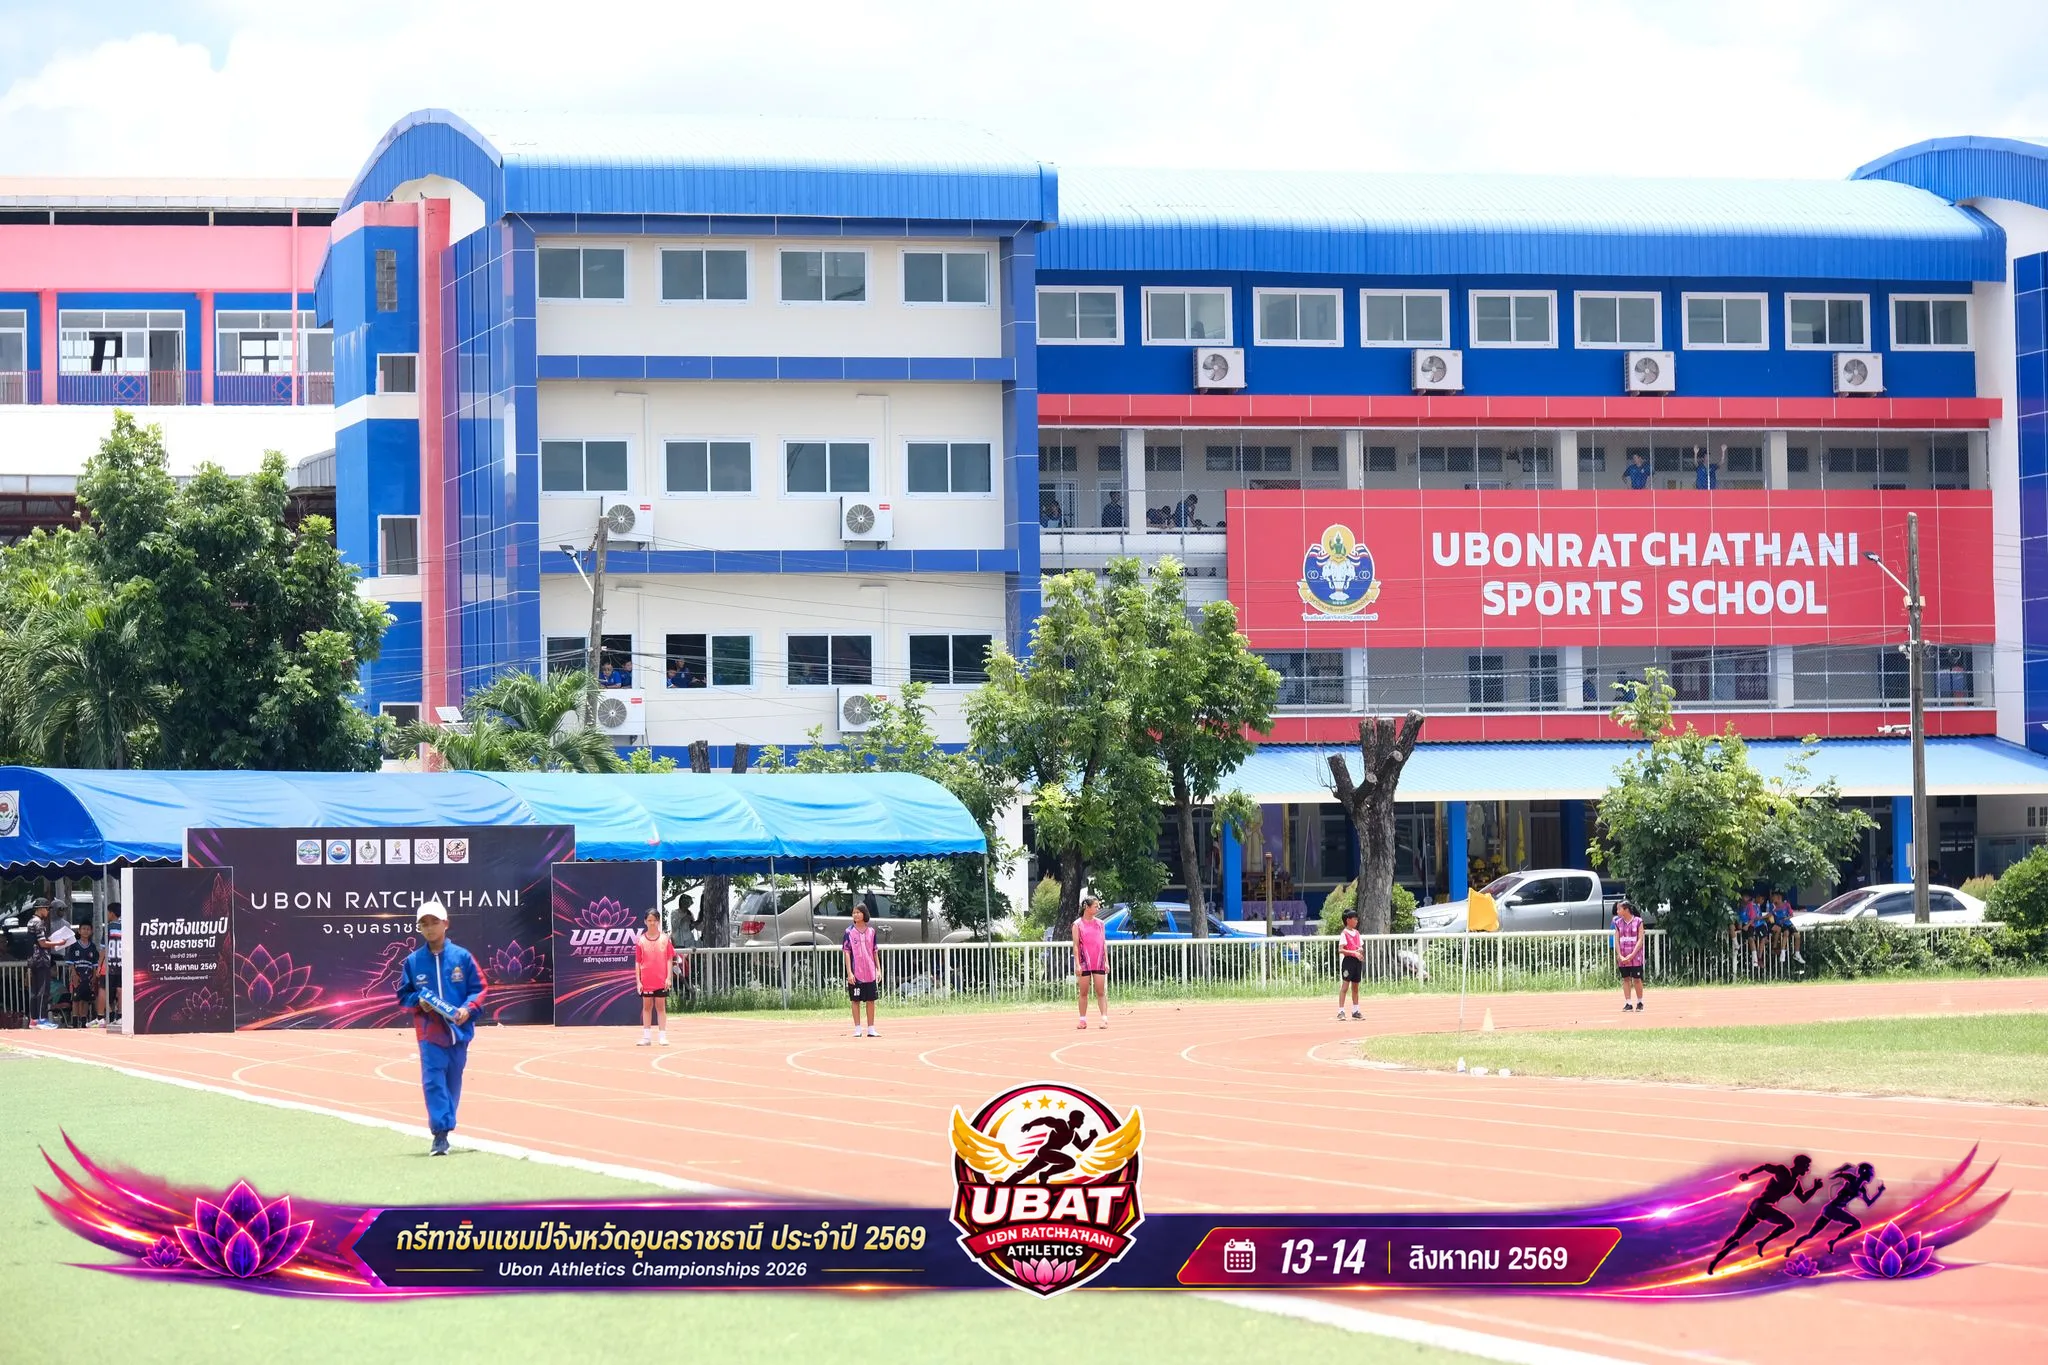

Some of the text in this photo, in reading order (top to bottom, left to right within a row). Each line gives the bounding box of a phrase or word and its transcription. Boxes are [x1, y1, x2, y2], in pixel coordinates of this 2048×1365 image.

[1432, 532, 1858, 567] UBONRATCHATHANI
[1483, 580, 1827, 616] SPORTS SCHOOL
[251, 891, 331, 910] UBON
[151, 936, 216, 952] จ.อุบลราชธานี
[570, 928, 644, 946] UBON
[571, 945, 636, 956] ATHLETICS
[152, 963, 172, 971] 12-14
[200, 962, 217, 970] 2569
[431, 996, 453, 1013] Double
